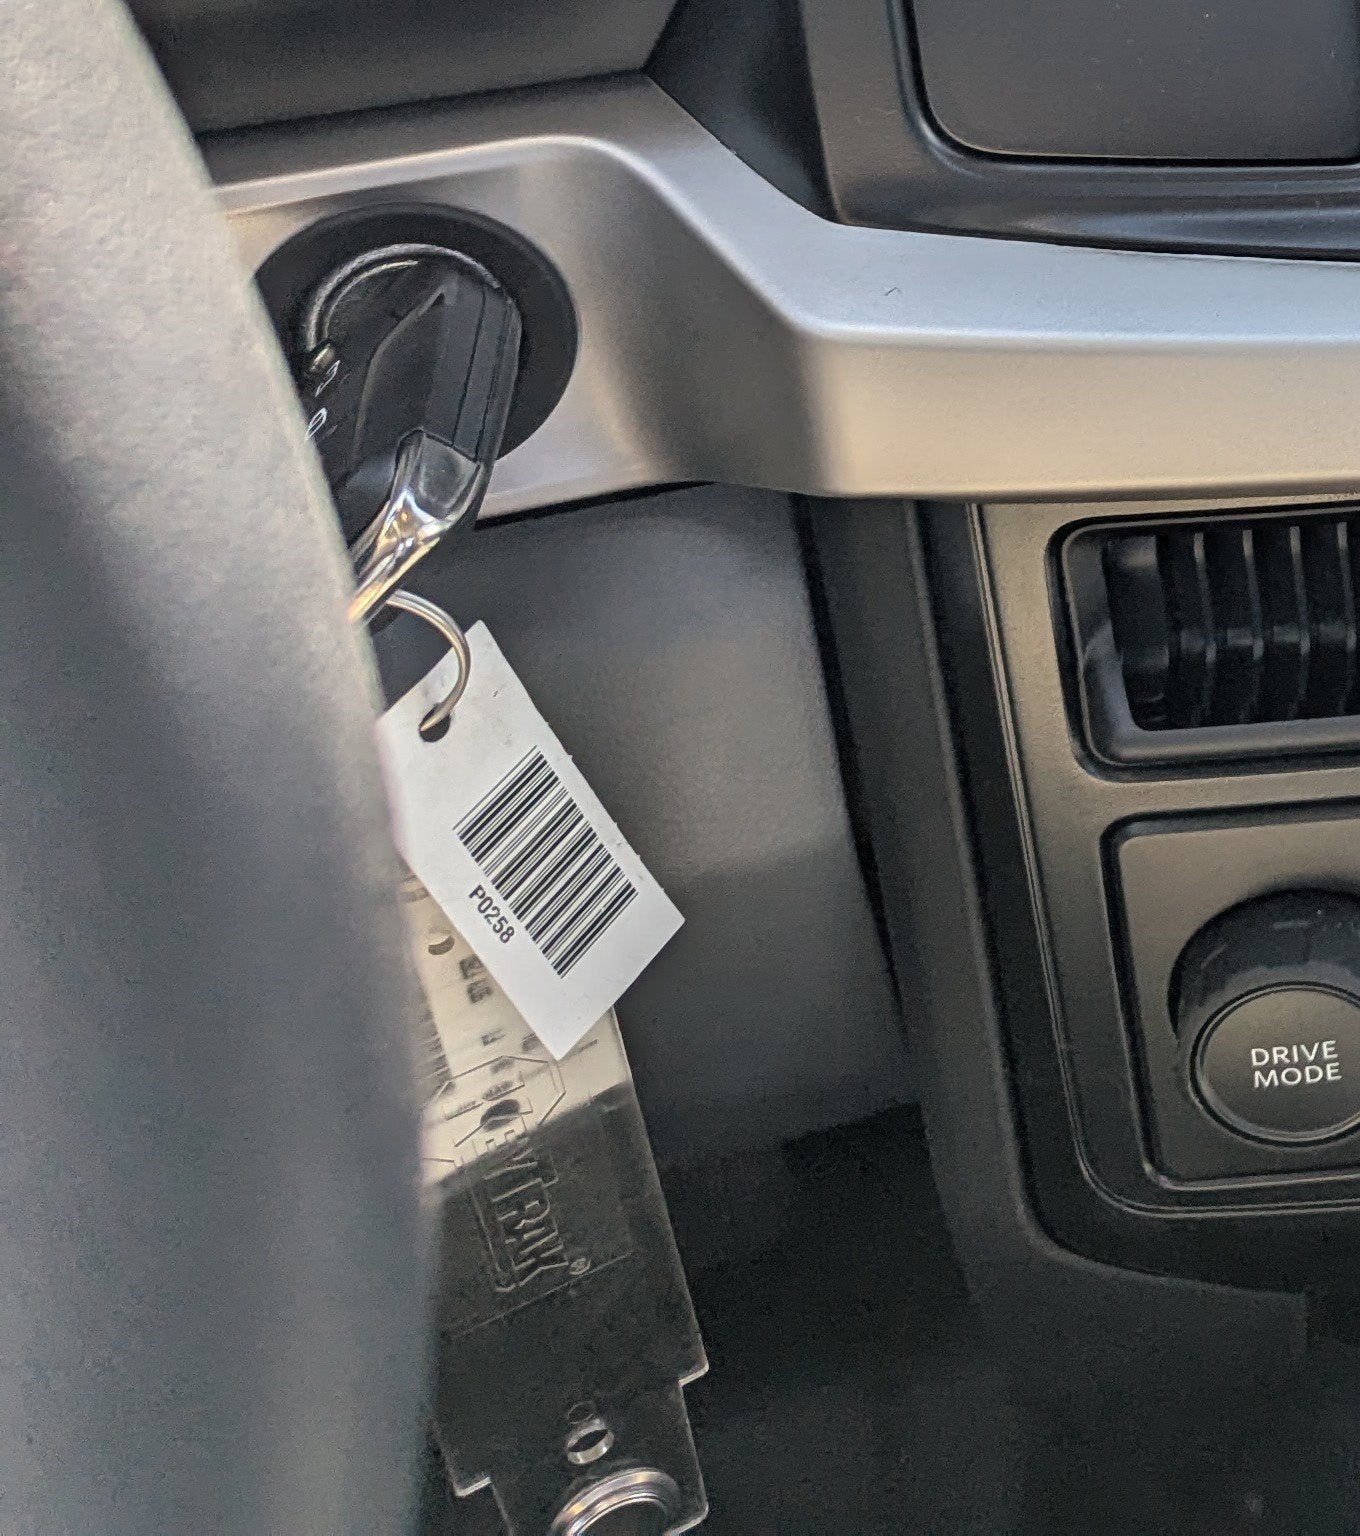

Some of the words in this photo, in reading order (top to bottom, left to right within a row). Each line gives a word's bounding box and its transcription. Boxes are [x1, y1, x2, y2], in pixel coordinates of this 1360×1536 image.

[469, 884, 516, 944] P0258
[1251, 1040, 1338, 1067] DRIVE
[1254, 1063, 1342, 1088] MODE
